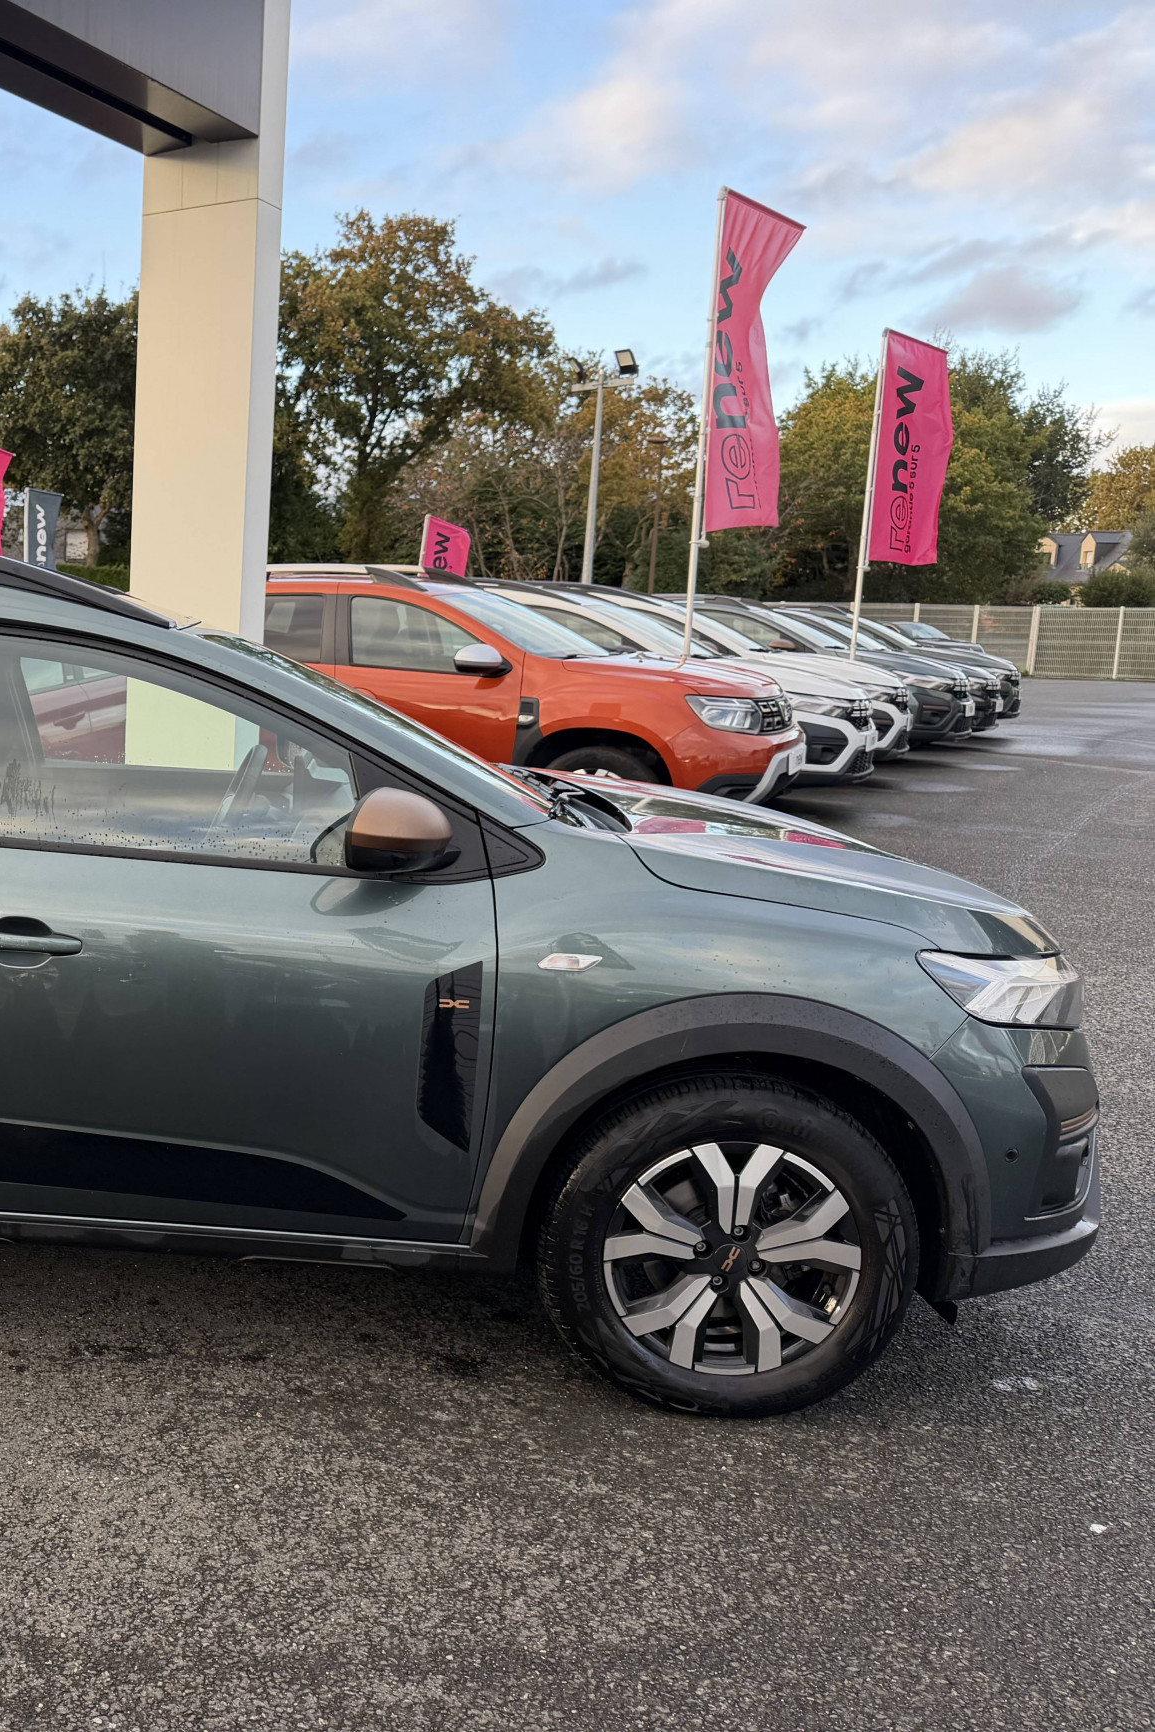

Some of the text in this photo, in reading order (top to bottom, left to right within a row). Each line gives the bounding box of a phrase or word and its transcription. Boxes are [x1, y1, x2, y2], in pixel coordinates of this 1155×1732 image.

[713, 246, 755, 510] renew
[890, 365, 925, 552] renew
[910, 456, 919, 478] sur
[911, 444, 921, 453] 5
[36, 504, 47, 567] new
[569, 1254, 591, 1313] 205/60
